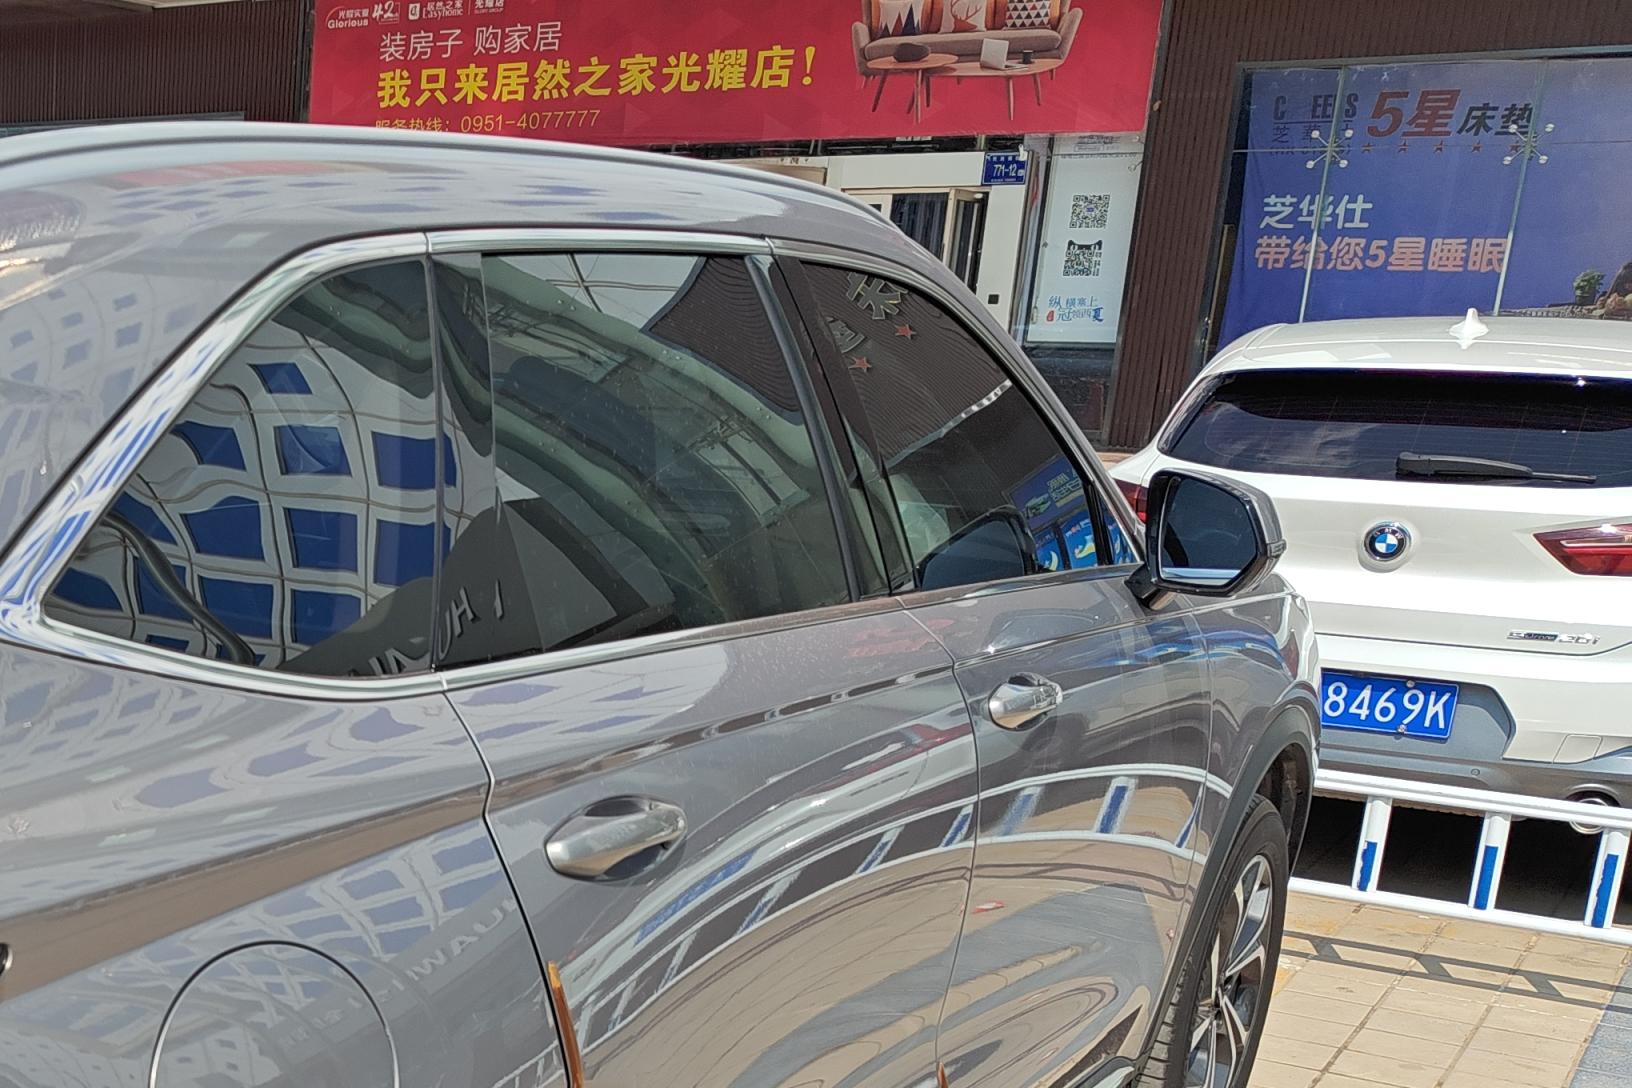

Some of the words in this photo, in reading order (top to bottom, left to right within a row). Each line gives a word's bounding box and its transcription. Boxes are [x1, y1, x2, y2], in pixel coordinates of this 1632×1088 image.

[327, 18, 369, 29] Glorious
[379, 28, 464, 62] 装房子
[473, 20, 562, 56] 购家居
[1259, 193, 1374, 230] 芝华仕
[1254, 234, 1508, 274] 带给您5星睡眠
[1323, 680, 1452, 729] 8469K
